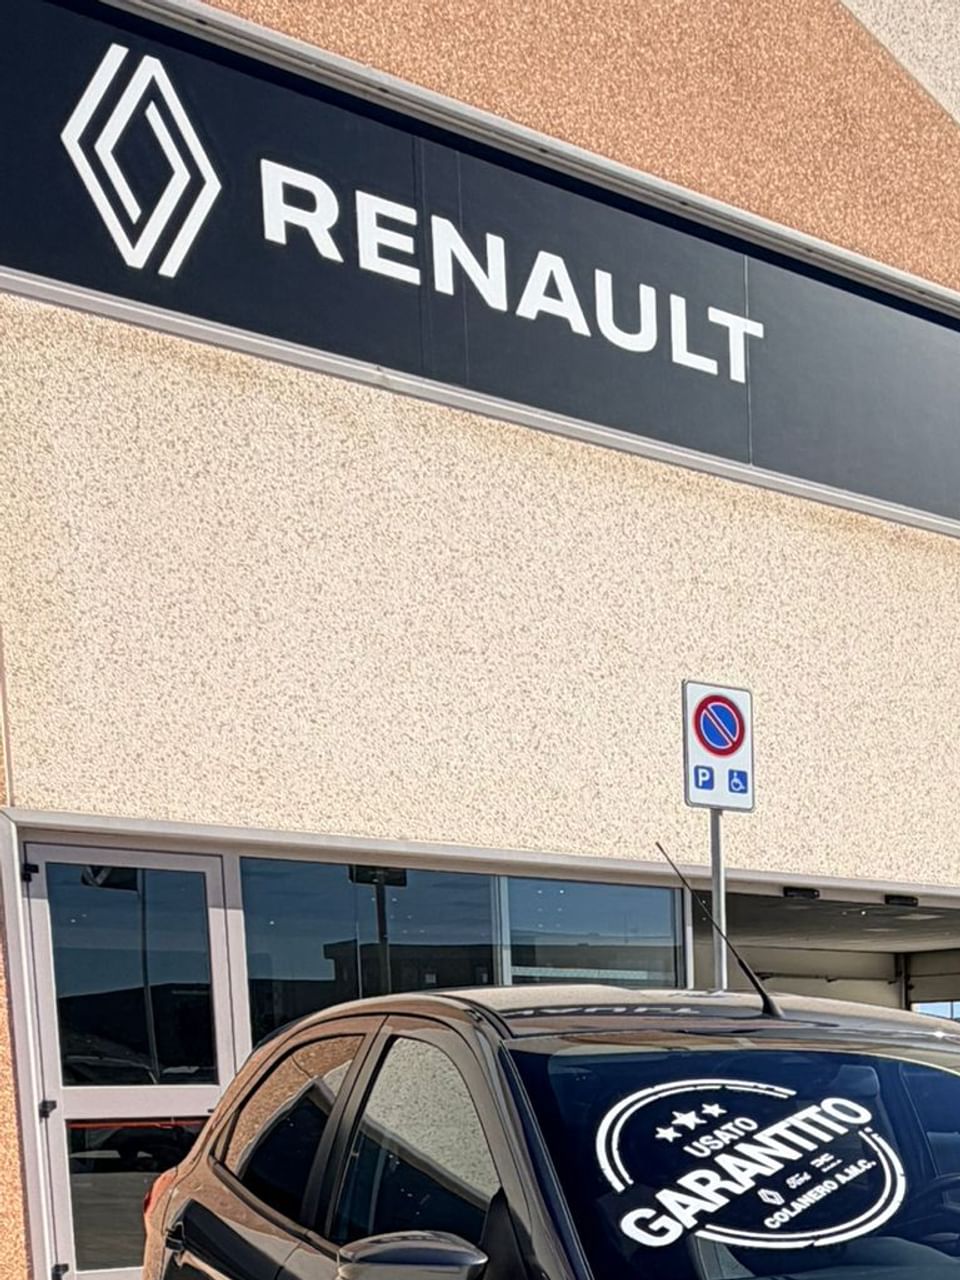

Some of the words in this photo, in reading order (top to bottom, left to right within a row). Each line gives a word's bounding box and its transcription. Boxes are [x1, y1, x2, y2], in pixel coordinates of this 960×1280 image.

[260, 159, 764, 383] RENAULT
[697, 767, 711, 787] P
[683, 1117, 759, 1158] USATO
[620, 1097, 873, 1248] GARANTITO
[763, 1179, 839, 1229] COLANERO
